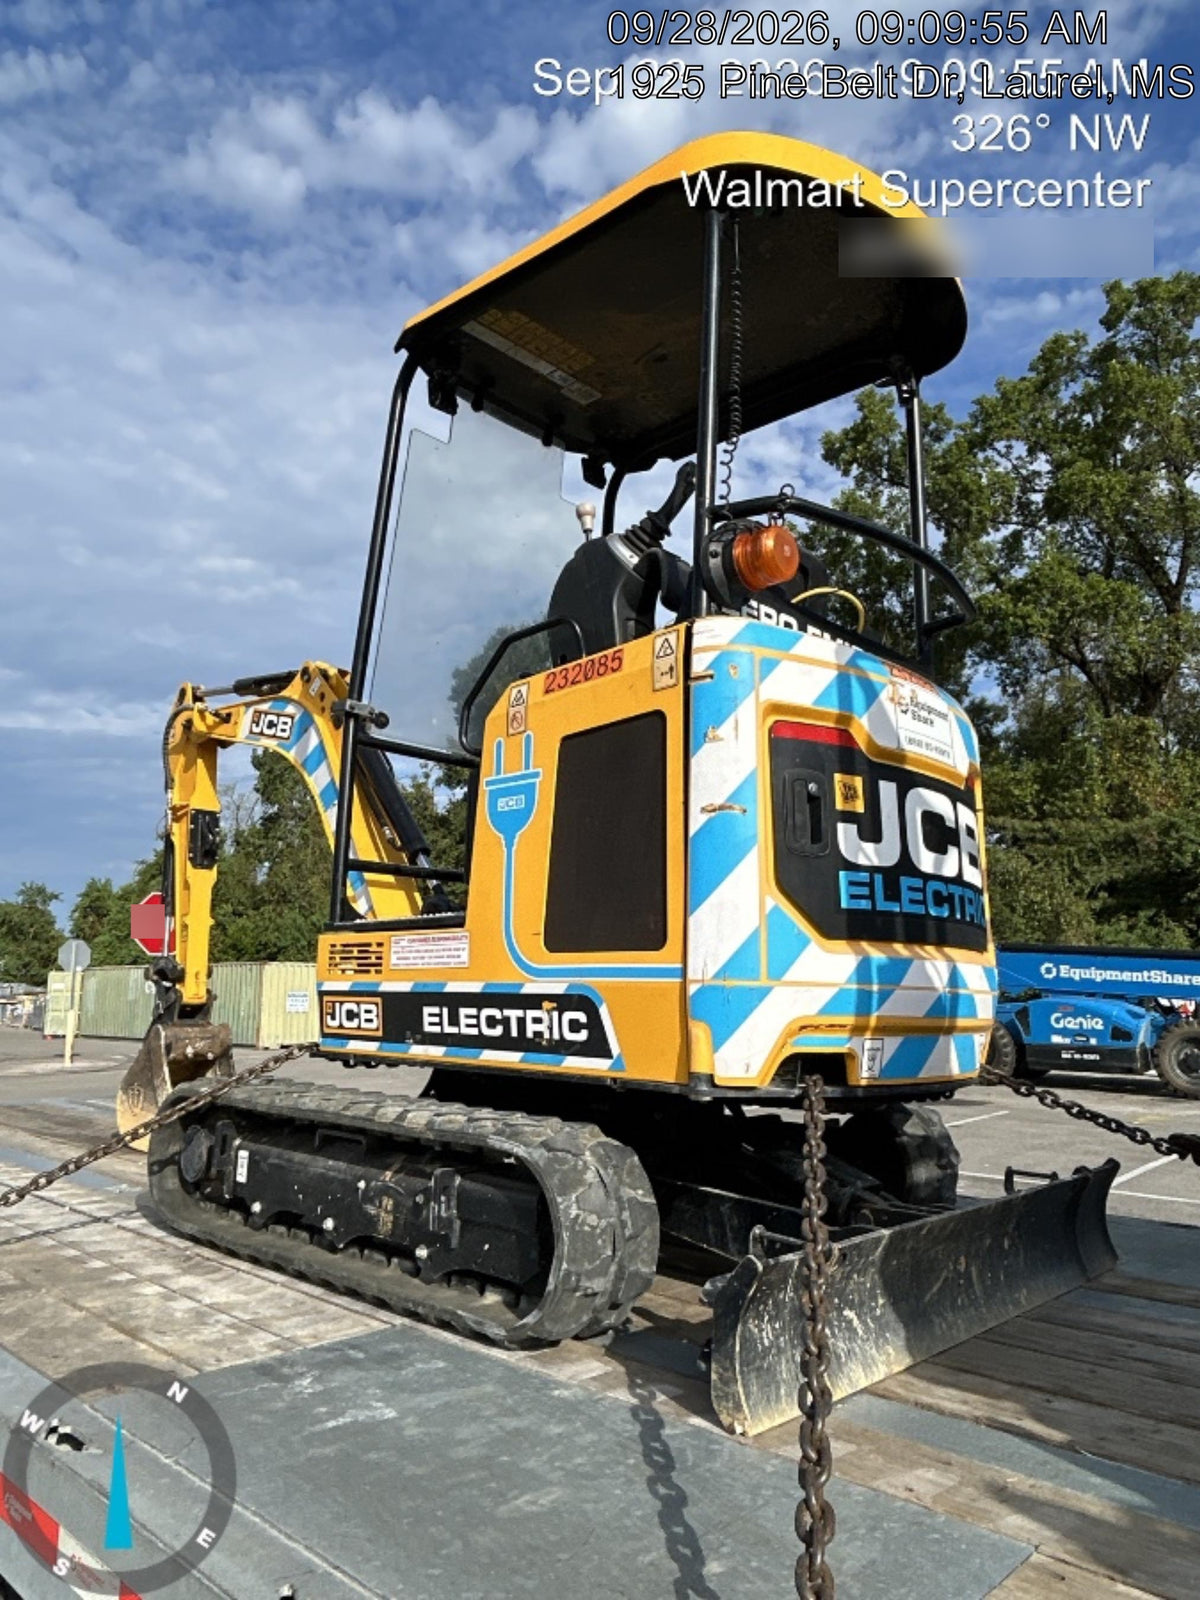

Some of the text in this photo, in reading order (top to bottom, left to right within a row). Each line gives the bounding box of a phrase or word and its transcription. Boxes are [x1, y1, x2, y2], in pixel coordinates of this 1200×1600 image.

[544, 647, 625, 695] 232085
[252, 713, 293, 739] JCB
[837, 779, 982, 890] JCB
[1058, 963, 1200, 985] EquipmentShare
[325, 1001, 379, 1030] JCB
[422, 1005, 589, 1042] ELECTRIC
[1050, 1012, 1105, 1030] Genie
